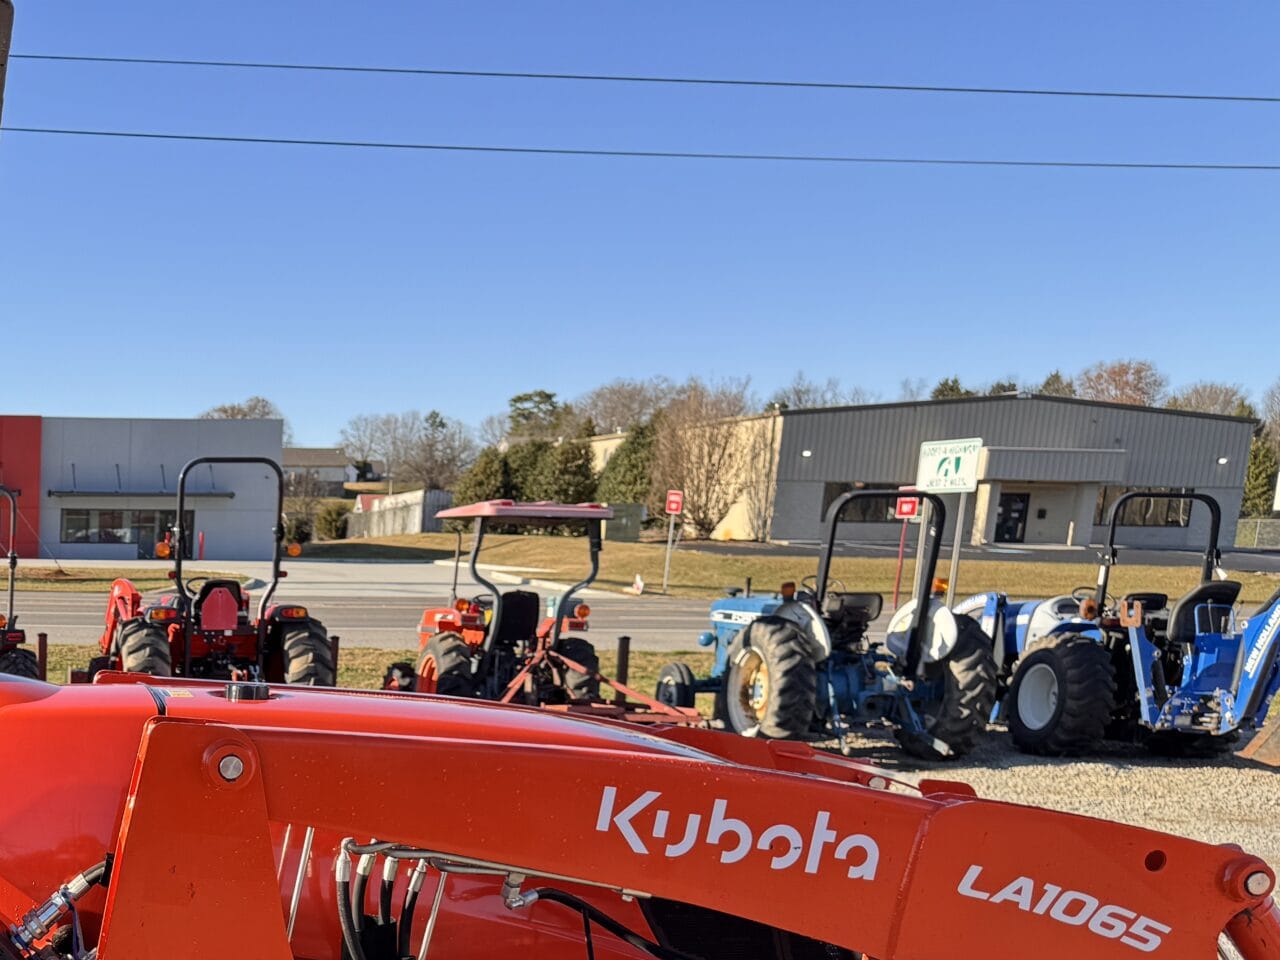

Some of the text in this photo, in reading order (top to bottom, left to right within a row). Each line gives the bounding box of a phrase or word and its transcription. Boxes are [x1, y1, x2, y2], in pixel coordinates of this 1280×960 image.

[1244, 647, 1260, 673] NEW
[595, 786, 880, 881] Kubota
[956, 865, 1172, 952] LA1065
